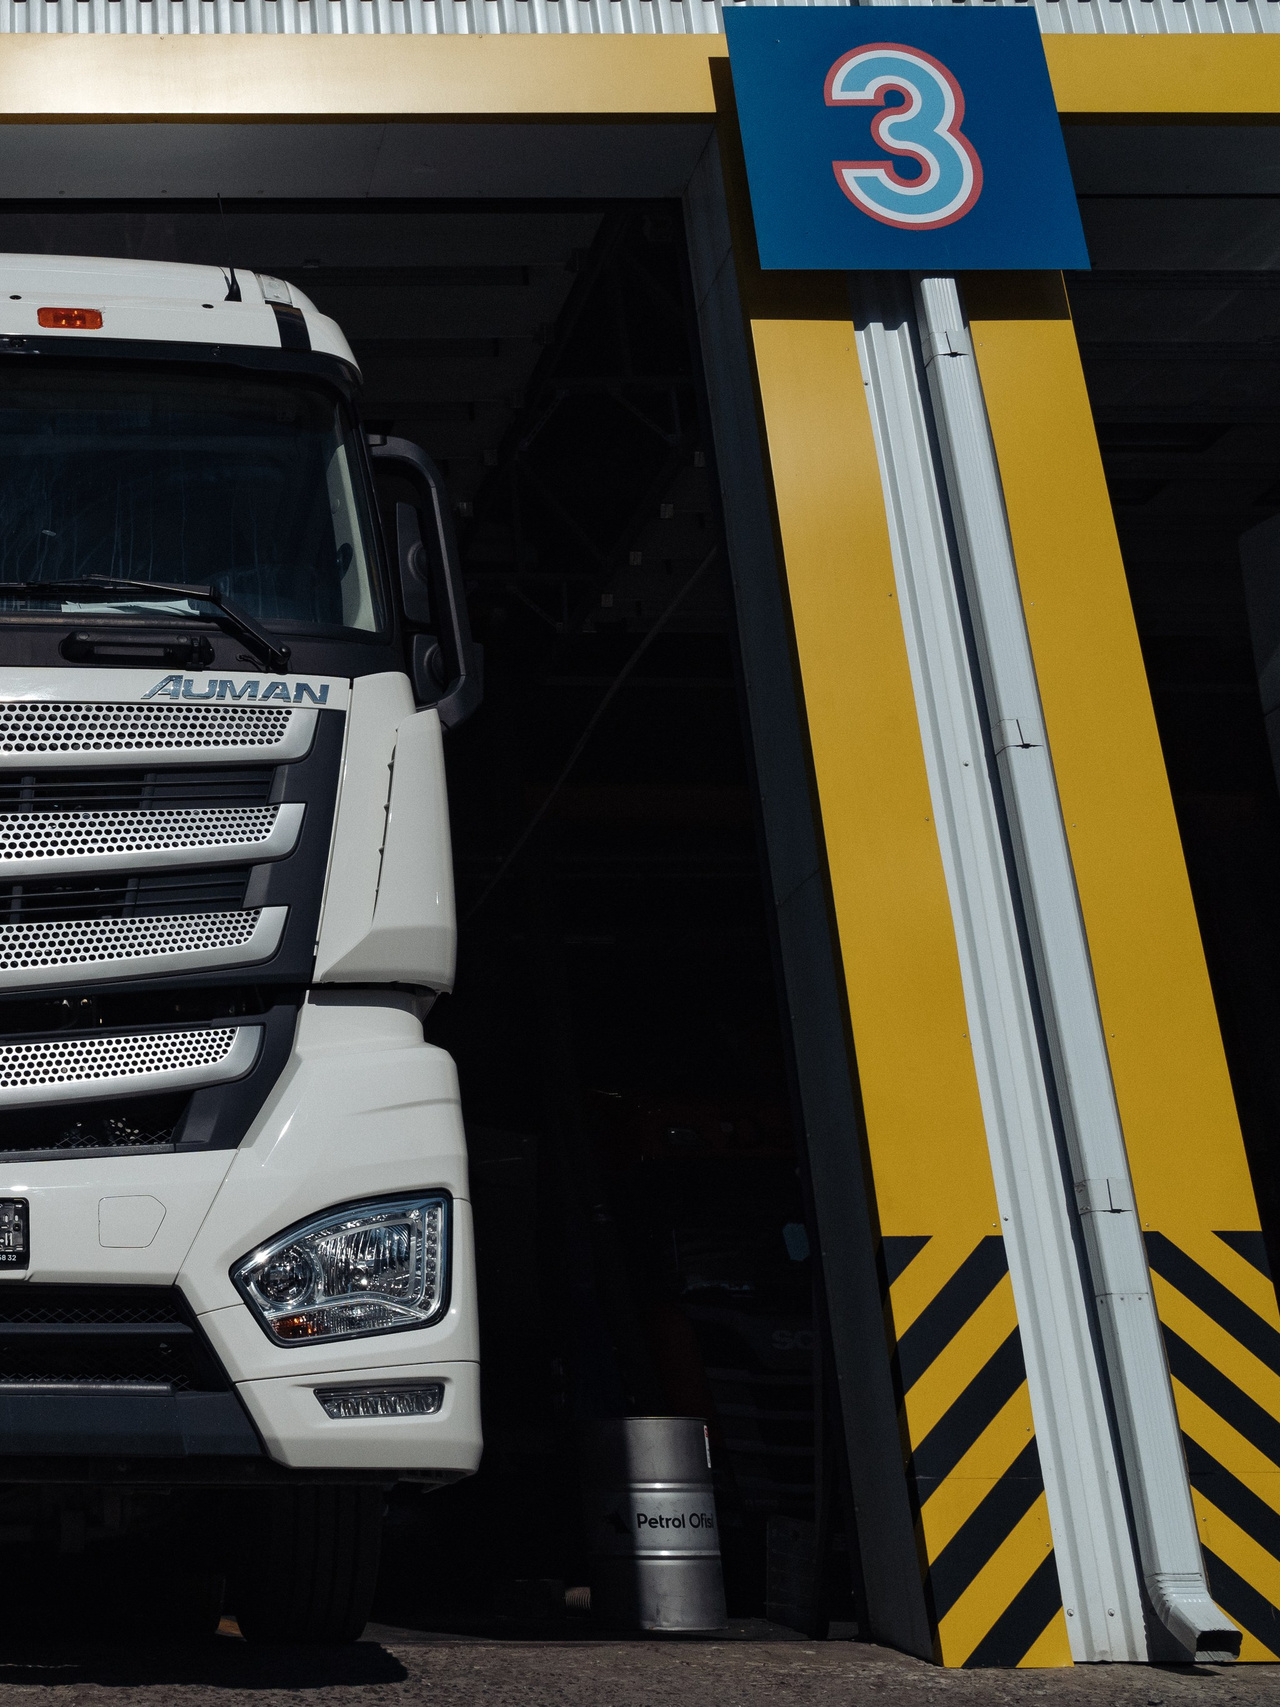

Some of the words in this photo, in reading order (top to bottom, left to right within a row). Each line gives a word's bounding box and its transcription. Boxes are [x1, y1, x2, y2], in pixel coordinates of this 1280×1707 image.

[823, 42, 984, 231] 3
[140, 674, 330, 705] AUMAN
[7, 1254, 17, 1262] 32
[636, 1512, 686, 1529] Petrol
